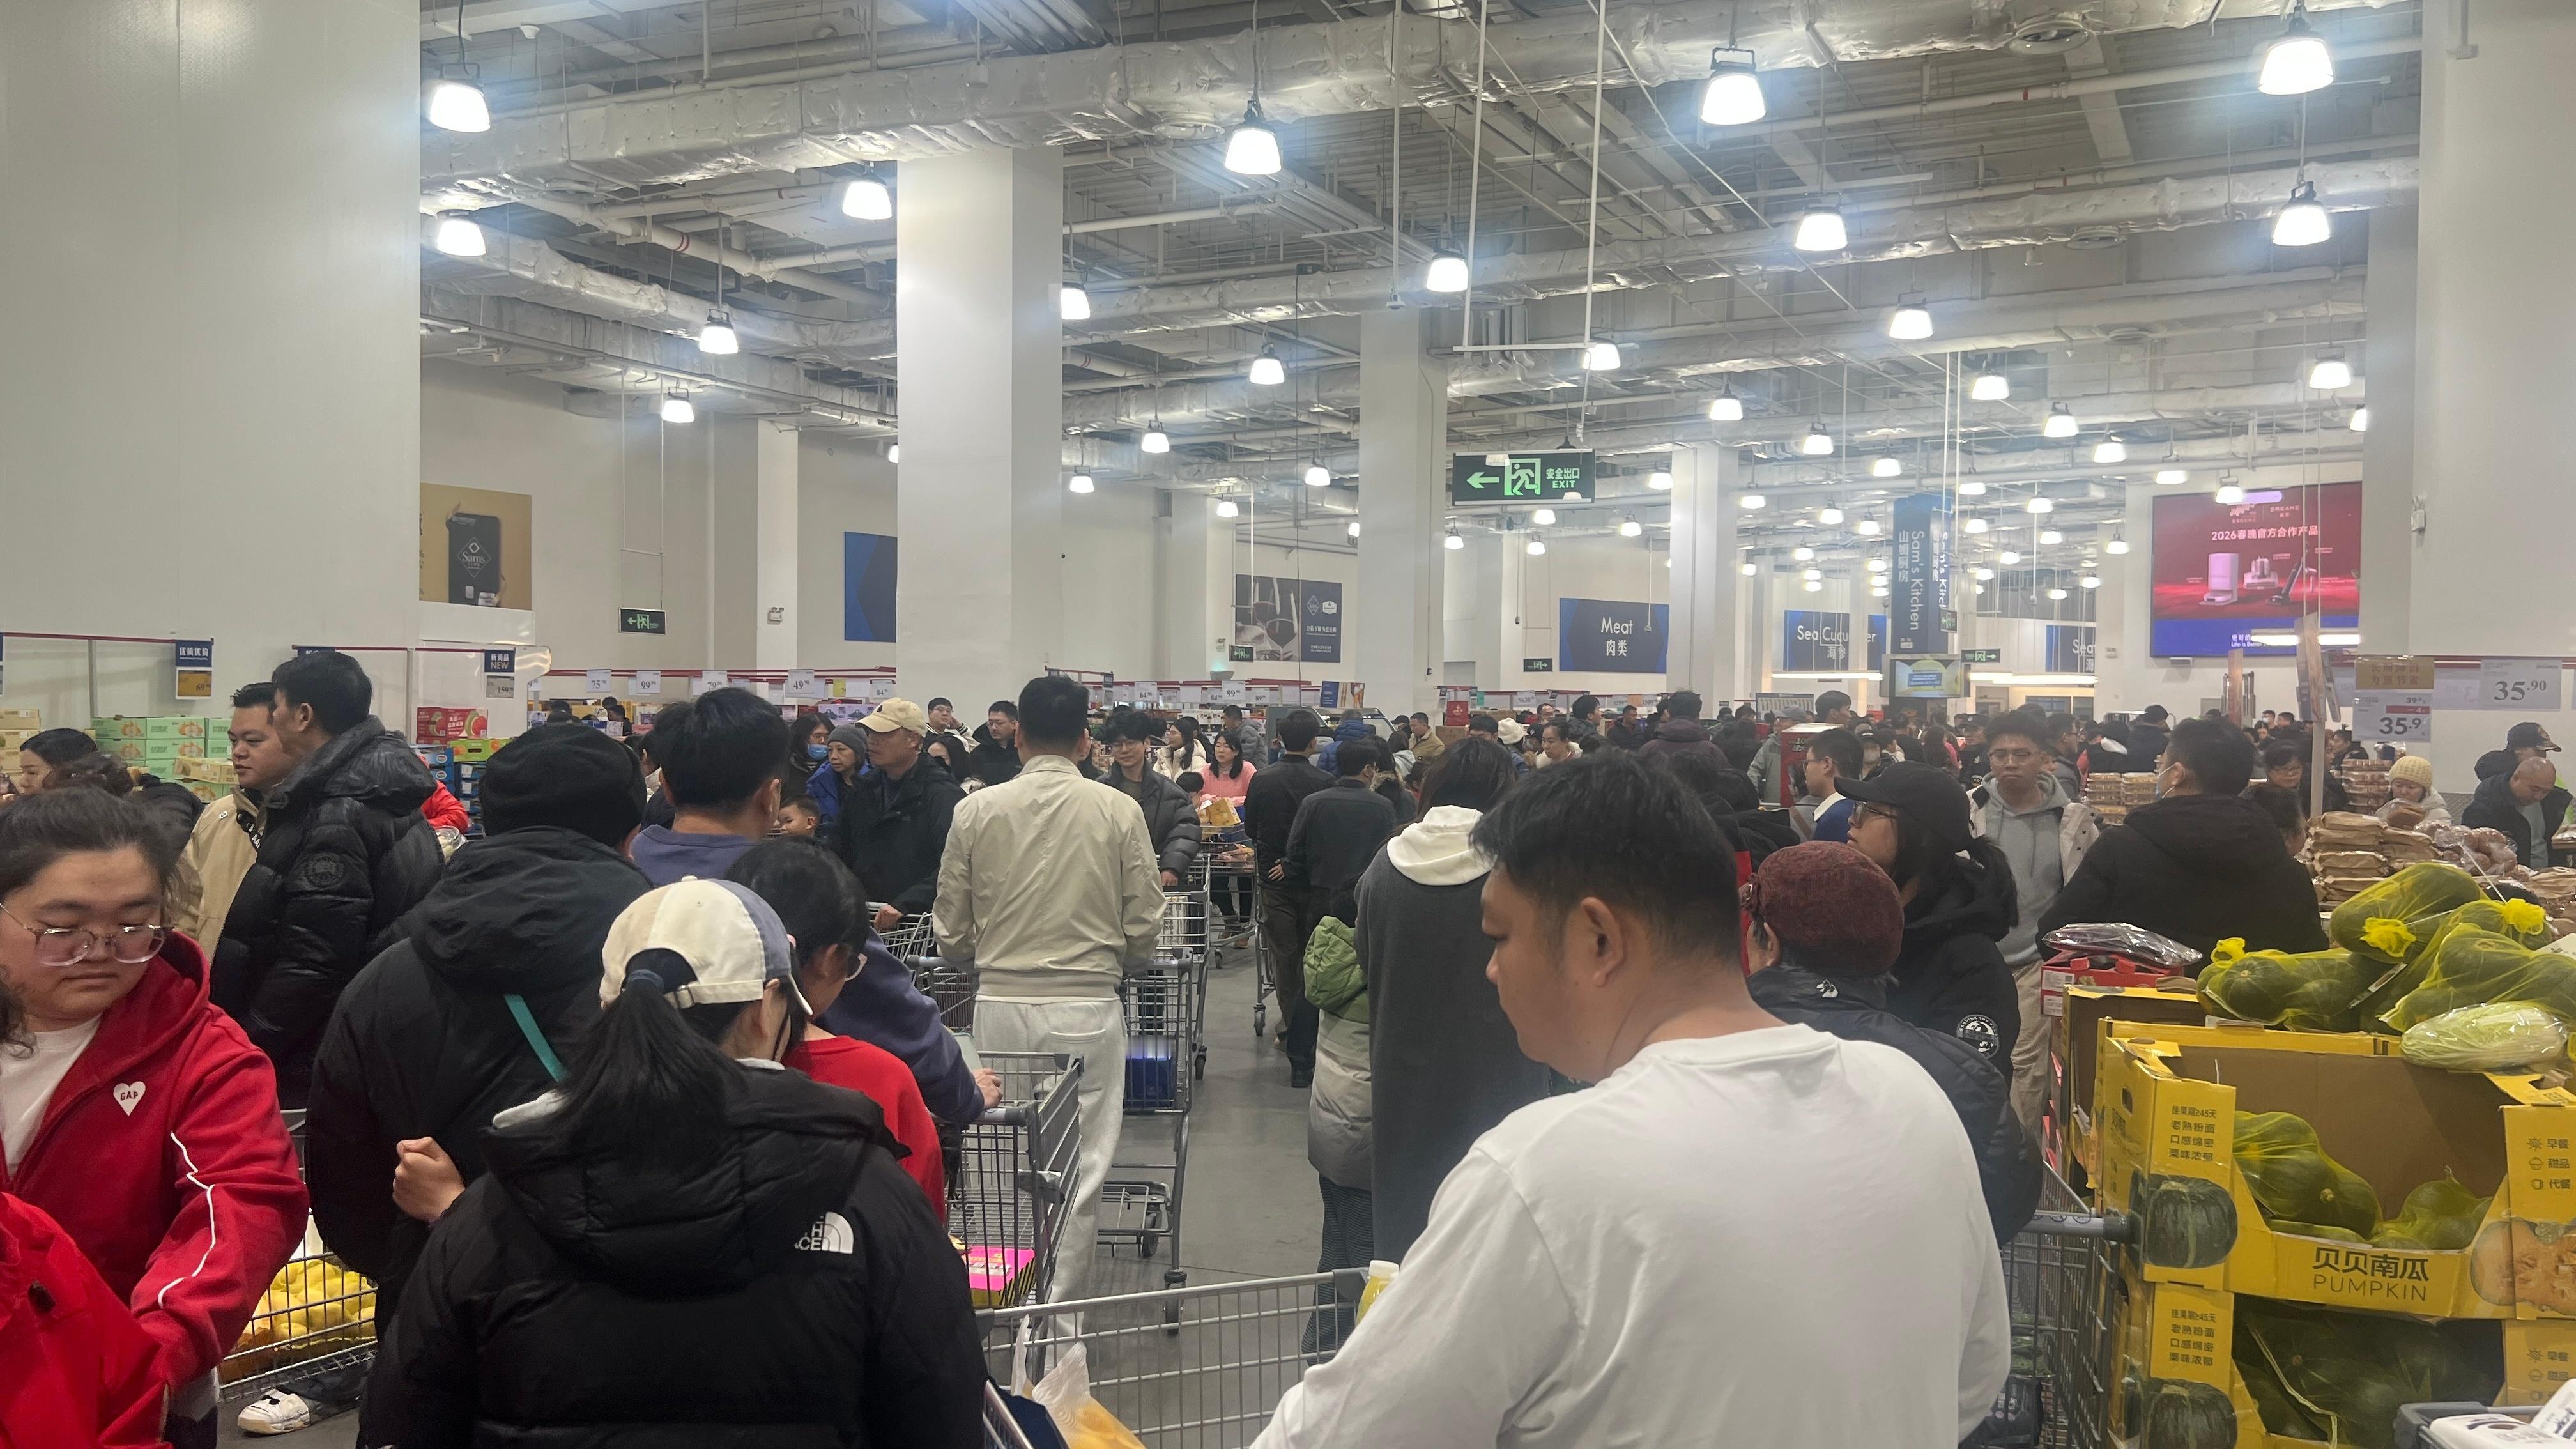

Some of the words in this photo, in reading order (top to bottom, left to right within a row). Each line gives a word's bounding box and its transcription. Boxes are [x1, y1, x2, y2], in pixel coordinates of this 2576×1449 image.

[1546, 468, 1580, 480] 安全出口
[1552, 480, 1575, 489] EXIT
[2211, 525, 2319, 541] 2026春晚官方合作产品
[1897, 530, 1909, 583] 山姆厨房
[1911, 530, 1924, 574] Sam's
[1910, 578, 1924, 631] Kitchen
[1600, 617, 1634, 634] Meat
[1797, 625, 1819, 640] Sea
[1822, 626, 1876, 643] Cucuer
[1606, 639, 1627, 657] 肉类
[2072, 638, 2094, 655] Sea
[491, 653, 509, 661] 新商品
[490, 661, 509, 670] NEW
[2493, 680, 2547, 701] 35.90
[2379, 717, 2422, 735] 35.9
[120, 1091, 139, 1101] GAP
[2170, 1120, 2215, 1134] 老熟粉面
[2170, 1134, 2214, 1148] 口感绵密
[2546, 1138, 2570, 1149] 早餐
[2547, 1158, 2570, 1169] 甜品
[2549, 1178, 2572, 1190] 代餐
[2312, 1246, 2429, 1282] 贝贝南瓜
[2313, 1273, 2426, 1301] PUMPKIN
